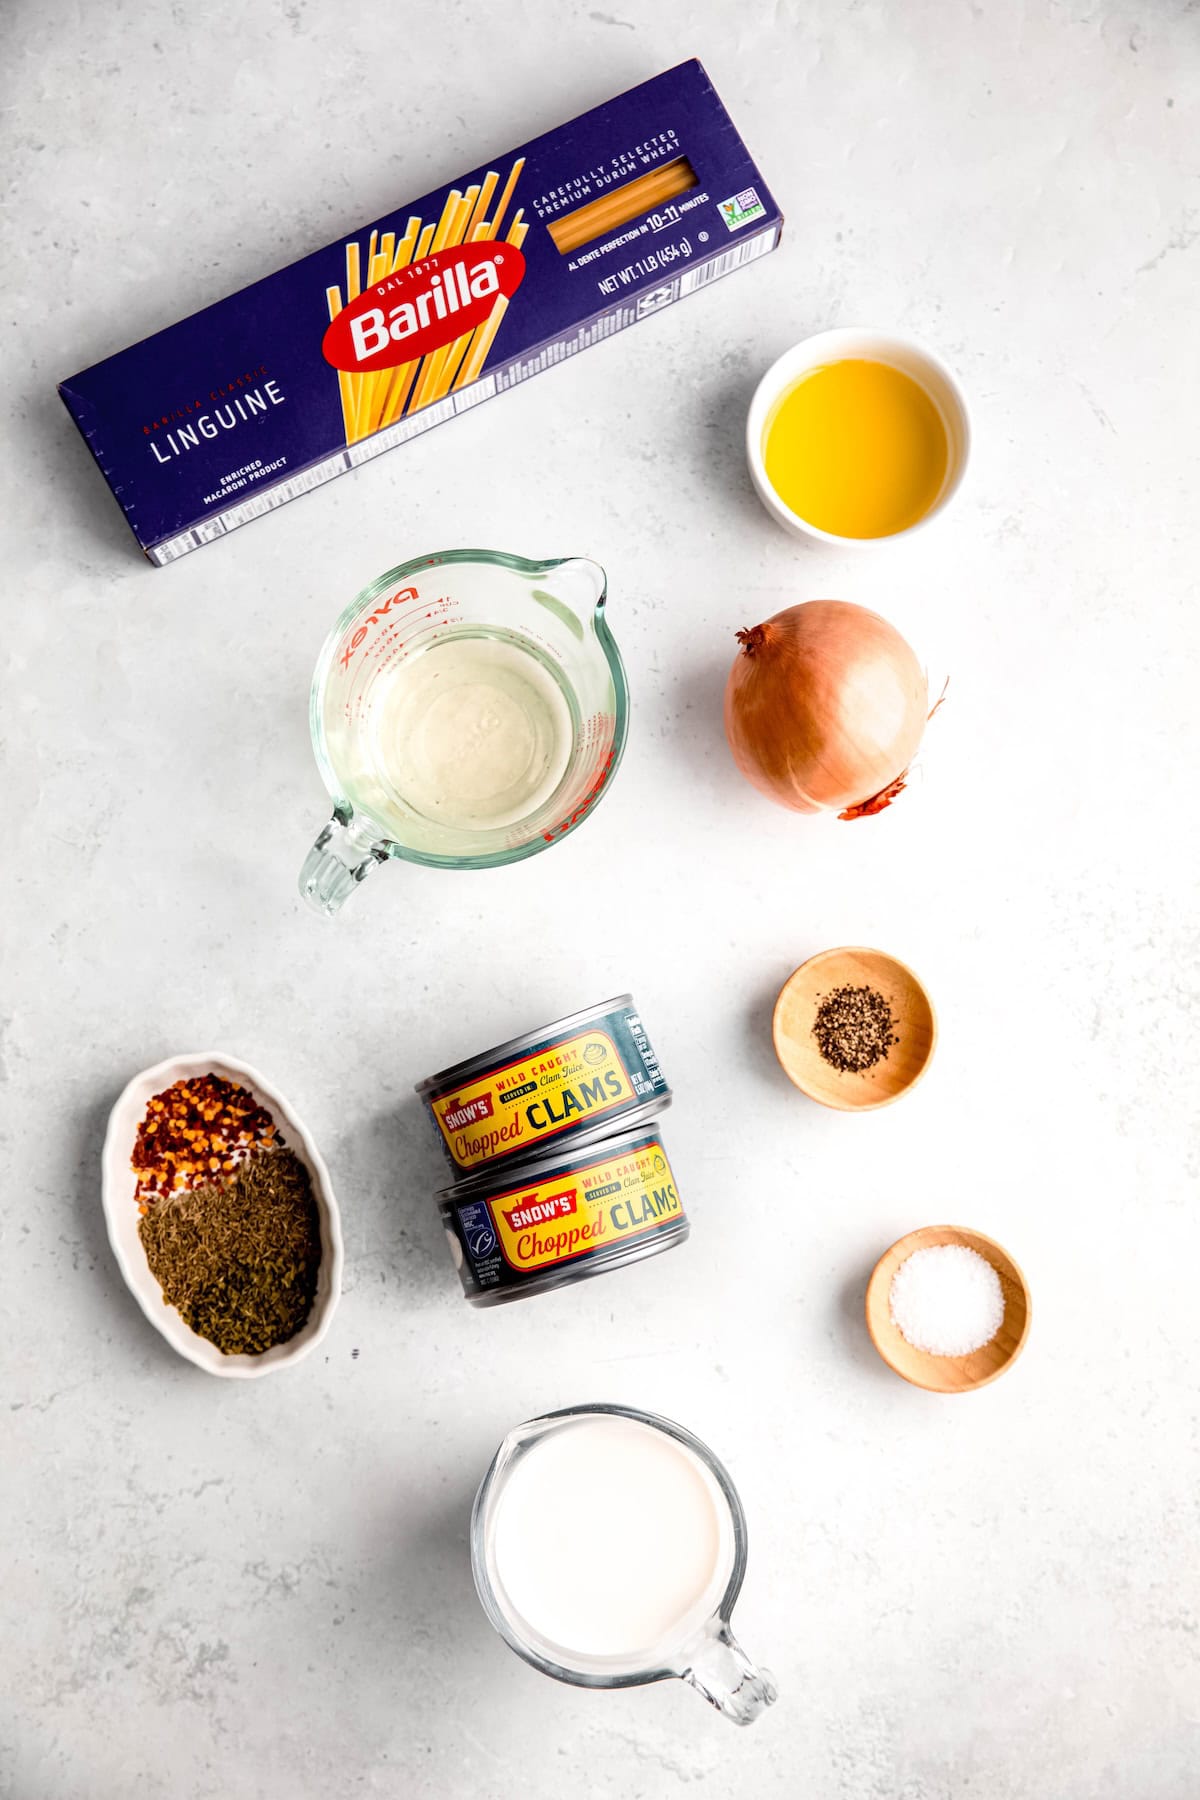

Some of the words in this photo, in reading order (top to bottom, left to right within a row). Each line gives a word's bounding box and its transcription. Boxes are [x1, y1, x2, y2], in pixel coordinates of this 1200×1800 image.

[533, 166, 605, 208] CAREFULLY
[611, 129, 676, 168] SELECTED
[538, 186, 591, 218] PREMIUM
[595, 163, 637, 188] DURUM
[641, 139, 681, 164] WHEAT
[568, 262, 579, 272] AL
[577, 249, 601, 266] DENTE
[600, 228, 640, 255] PERFECTION
[639, 224, 649, 234] IN
[646, 205, 679, 230] 10-11
[678, 193, 710, 214] MINUTES
[376, 278, 404, 296] DAL
[407, 259, 439, 279] 1877
[598, 274, 620, 296] NET
[617, 266, 639, 285] WT.
[635, 261, 645, 276] 1
[642, 255, 658, 273] LB
[656, 244, 681, 267] (454
[679, 237, 693, 258] g)
[350, 260, 500, 362] Barilla
[143, 400, 202, 436] BARILLA
[209, 365, 268, 401] CLASSIC
[150, 380, 285, 464] LINGUINE
[203, 478, 247, 505] MACARONI
[249, 456, 288, 481] PRODUCT
[220, 459, 262, 486] ENRICHED
[495, 1072, 526, 1092] WILD
[531, 1049, 578, 1076] CAUGHT
[539, 1072, 561, 1087] Clam
[561, 1063, 584, 1078] Juice
[445, 1100, 489, 1130] SNOW'S
[455, 1111, 524, 1160] Chopped
[525, 1070, 623, 1130] CLAMS
[503, 1087, 524, 1102] SERVED
[582, 1171, 612, 1189] WILD
[616, 1157, 651, 1177] CAUGHT
[589, 1188, 610, 1199] SERVED
[623, 1177, 640, 1188] Clam
[640, 1171, 655, 1183] Juice
[511, 1196, 571, 1228] SNOW'S
[516, 1210, 606, 1261] Chopped
[609, 1184, 678, 1231] CLAMS
